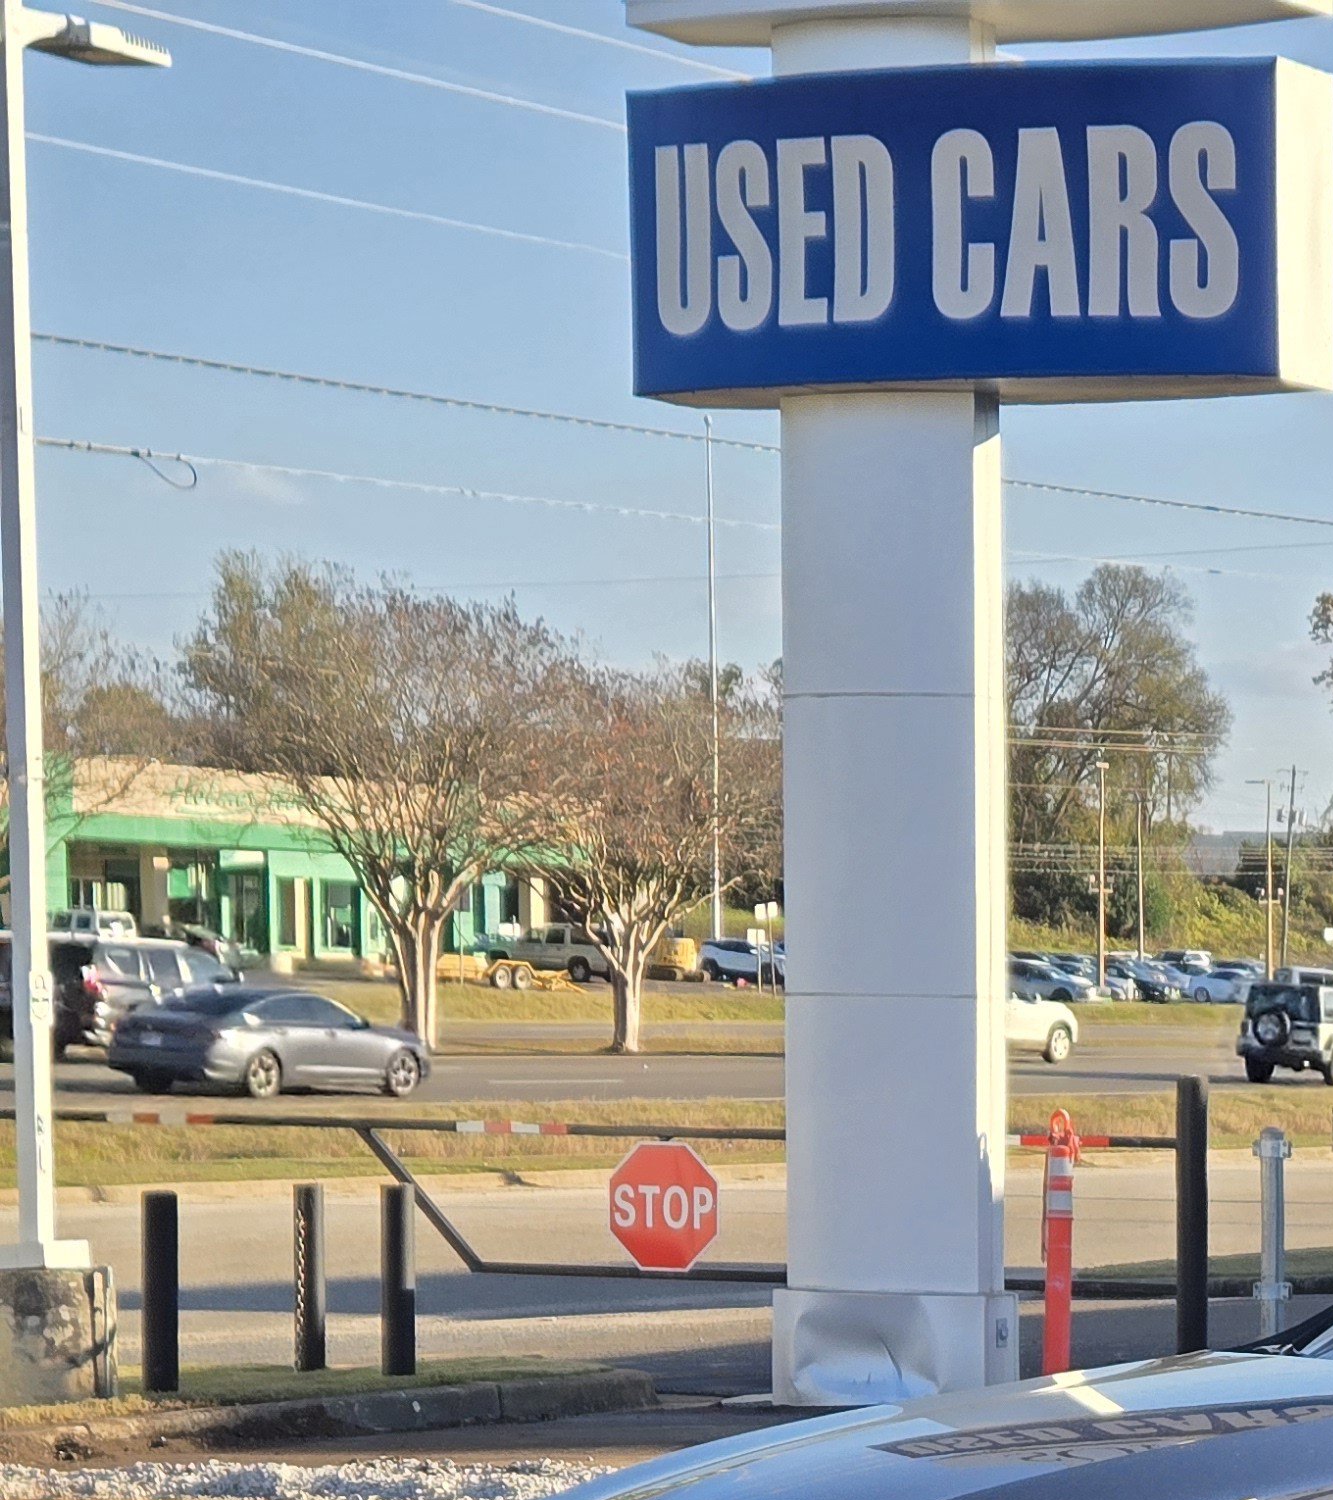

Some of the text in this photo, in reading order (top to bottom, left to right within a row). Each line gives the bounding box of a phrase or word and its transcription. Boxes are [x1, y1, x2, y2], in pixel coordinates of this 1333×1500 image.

[655, 120, 1240, 336] USED CARS
[614, 1183, 714, 1230] STOP
